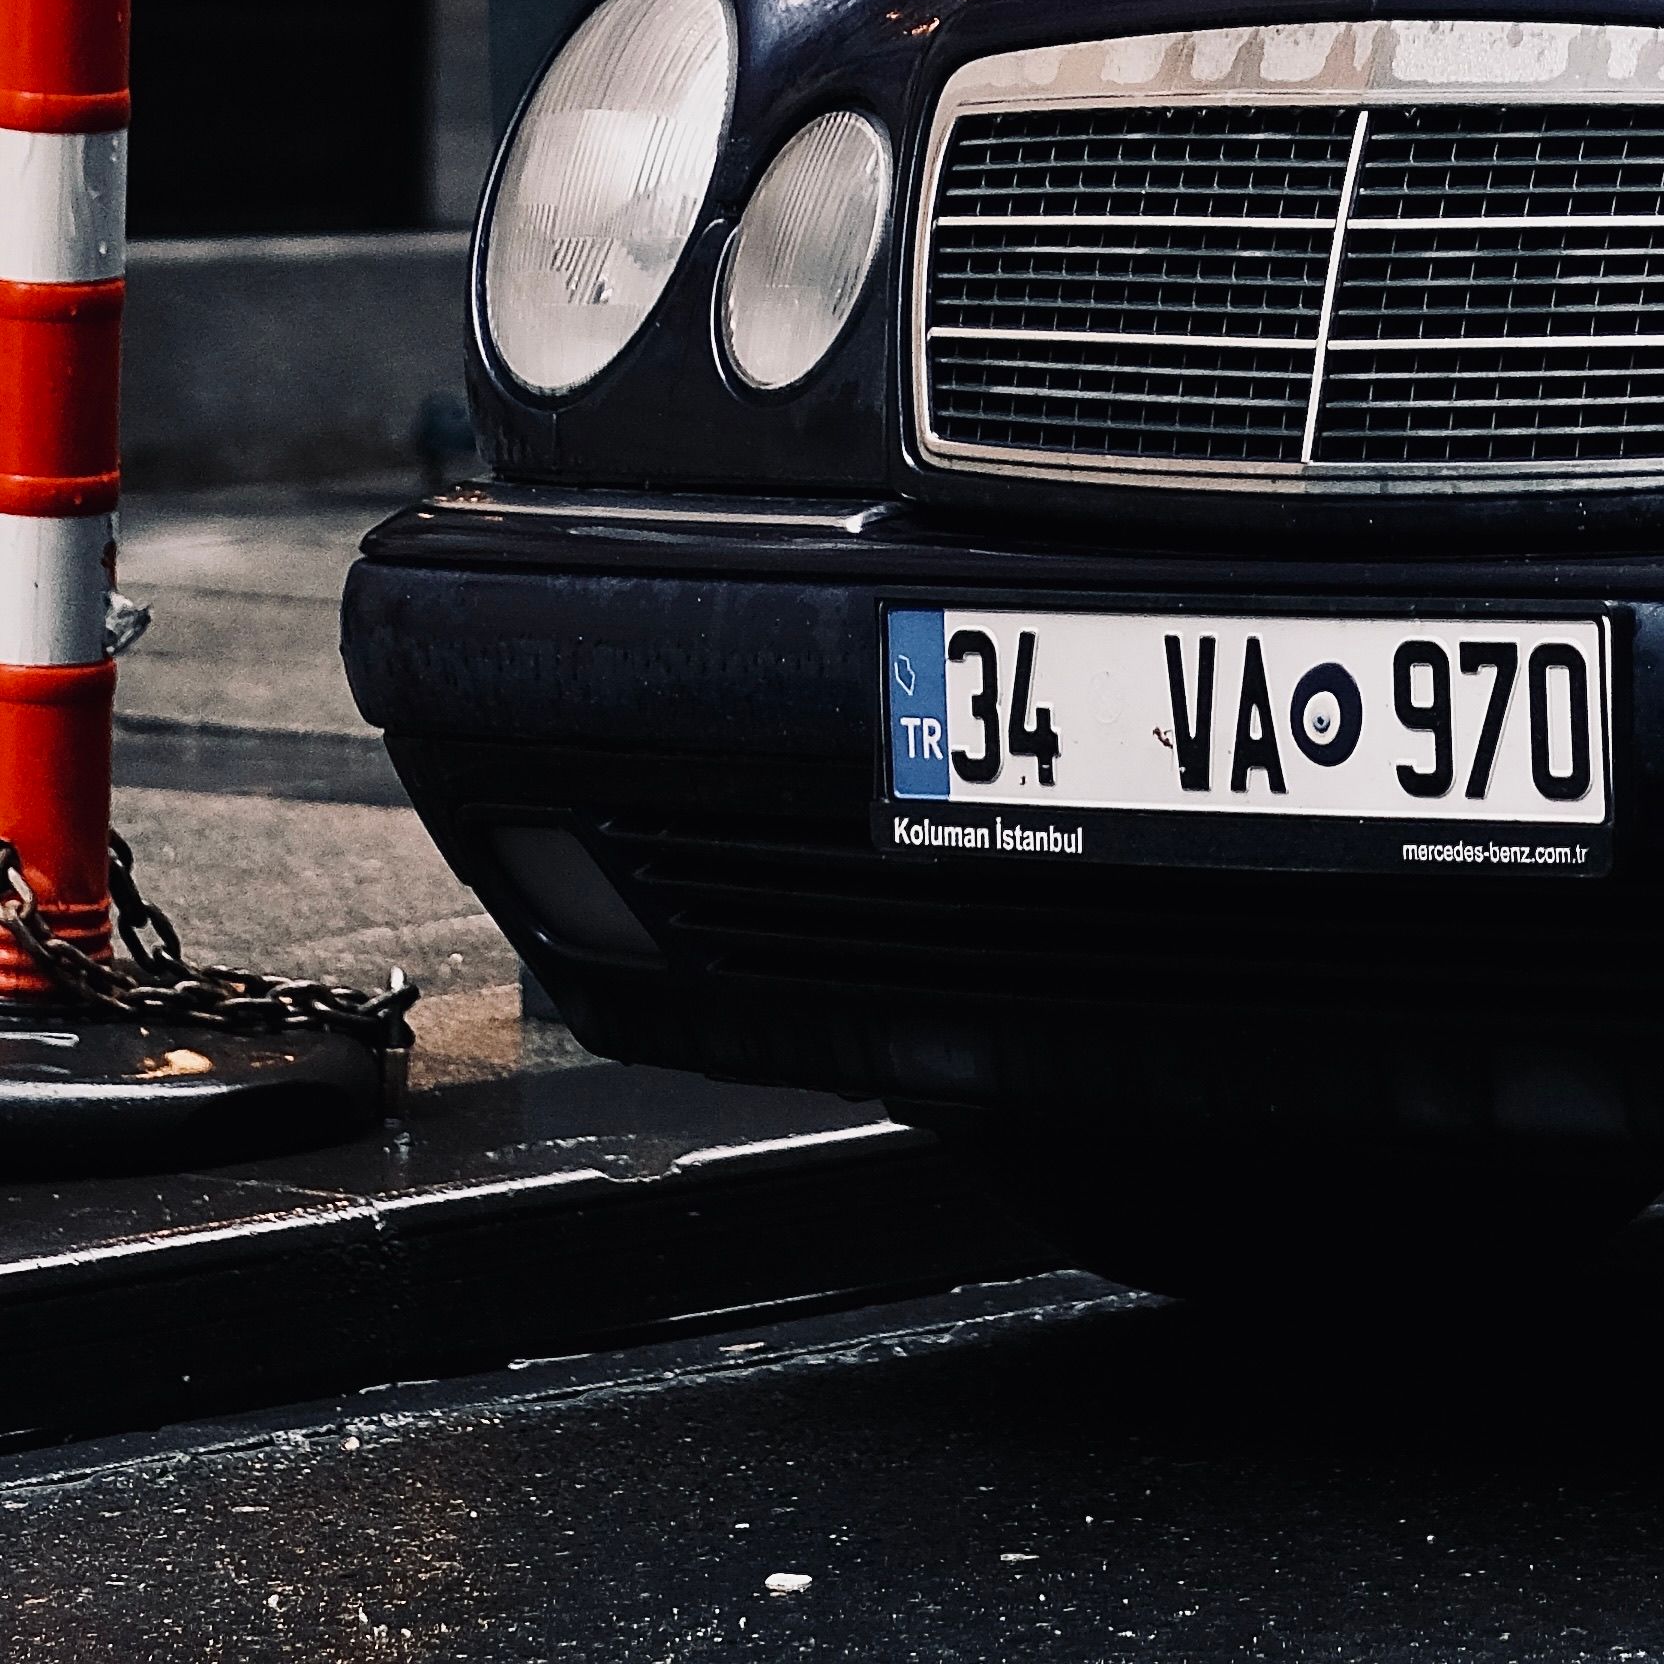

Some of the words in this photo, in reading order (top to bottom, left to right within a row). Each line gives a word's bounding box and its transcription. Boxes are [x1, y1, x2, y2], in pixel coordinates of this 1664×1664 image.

[947, 629, 1060, 787] 34
[1163, 633, 1288, 795] VA
[1393, 639, 1594, 802] 970
[900, 717, 943, 760] TR
[894, 816, 989, 849] Koluman
[996, 816, 1083, 854] İstanbul
[1402, 840, 1590, 864] mercedes-benz.com.tr
